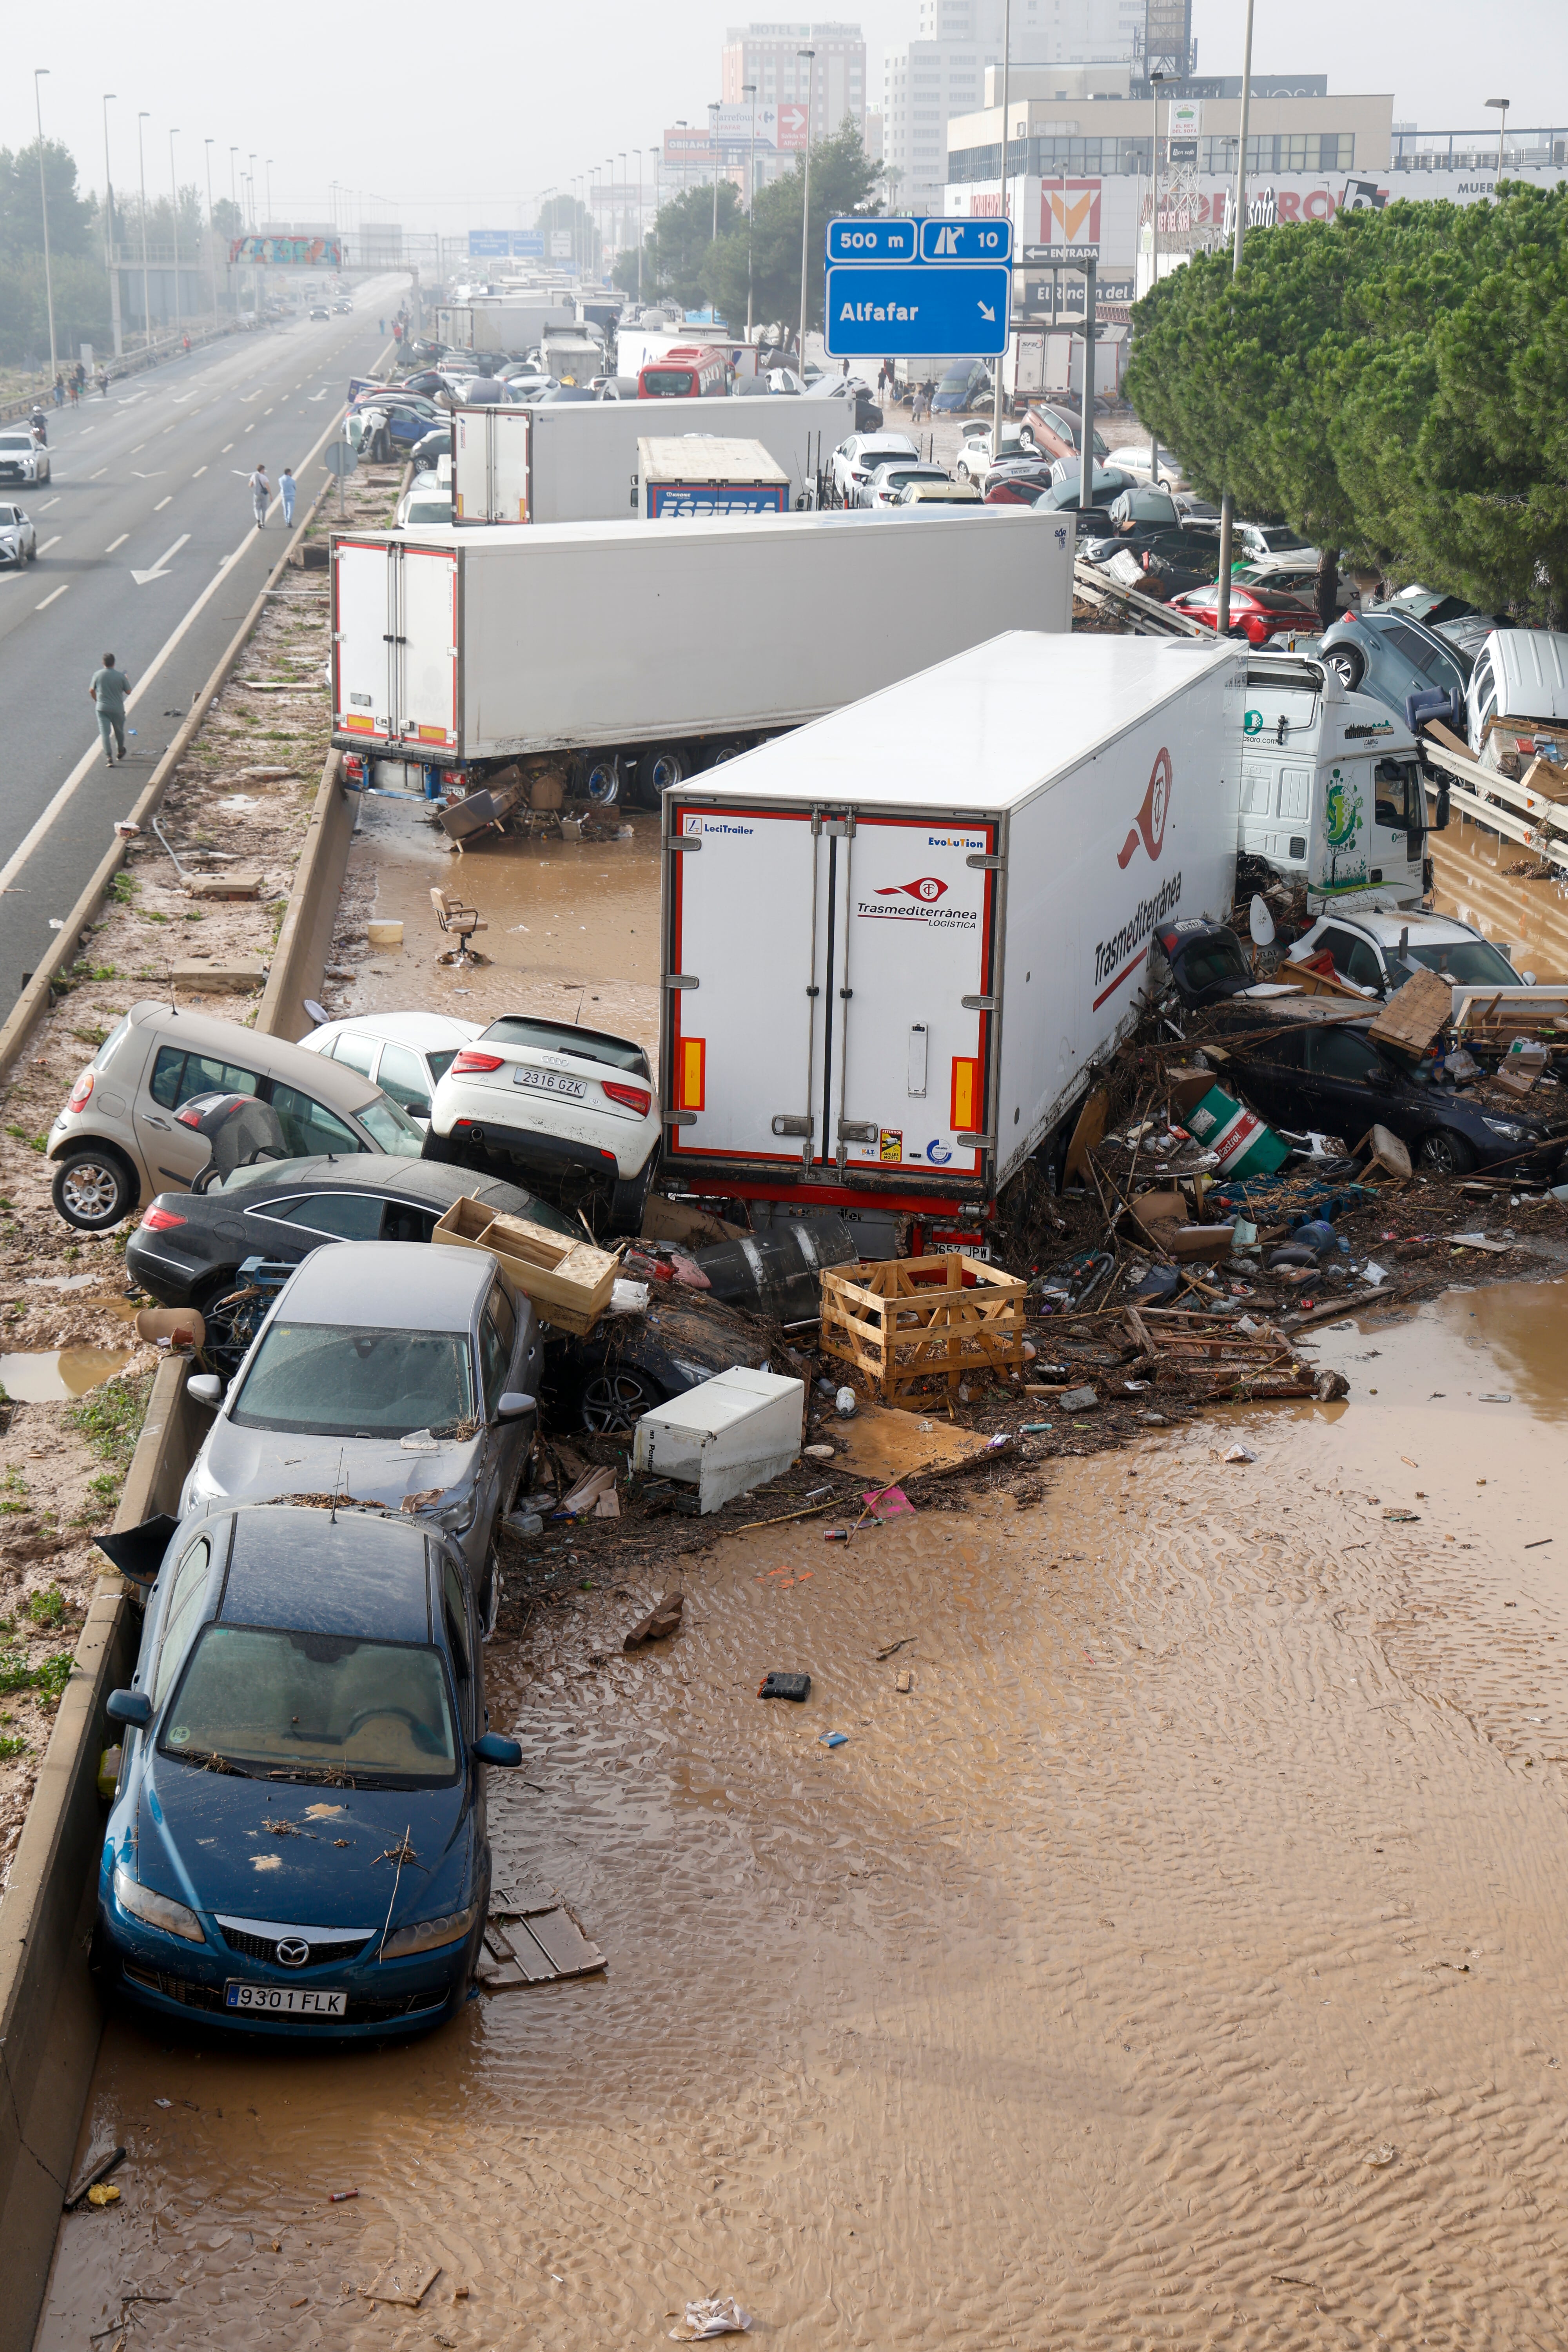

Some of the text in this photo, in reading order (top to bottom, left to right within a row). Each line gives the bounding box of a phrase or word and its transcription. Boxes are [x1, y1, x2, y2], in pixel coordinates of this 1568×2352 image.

[751, 25, 861, 37] HOTEL Albufera
[1457, 183, 1494, 193] MUEB
[1168, 212, 1176, 232] DEL
[840, 233, 904, 248] 500 m
[978, 232, 998, 248] 10
[1051, 249, 1098, 257] ENTRADA
[1038, 287, 1050, 300] El
[1106, 287, 1128, 299] del
[840, 302, 918, 321] Alfafar
[1243, 736, 1278, 745] asaro.com
[704, 824, 754, 835] LeciTrailer
[857, 903, 977, 920] Trasmediterránea
[929, 920, 976, 929] LOGÍSTICA
[1095, 871, 1181, 986] Trasmediterránea
[523, 1072, 551, 1087] 2316
[558, 1080, 582, 1094] GZK
[1218, 1131, 1242, 1158] Castrol
[965, 1246, 987, 1259] JPW
[240, 1989, 294, 2009] 9301
[301, 1994, 341, 2012] FLK
